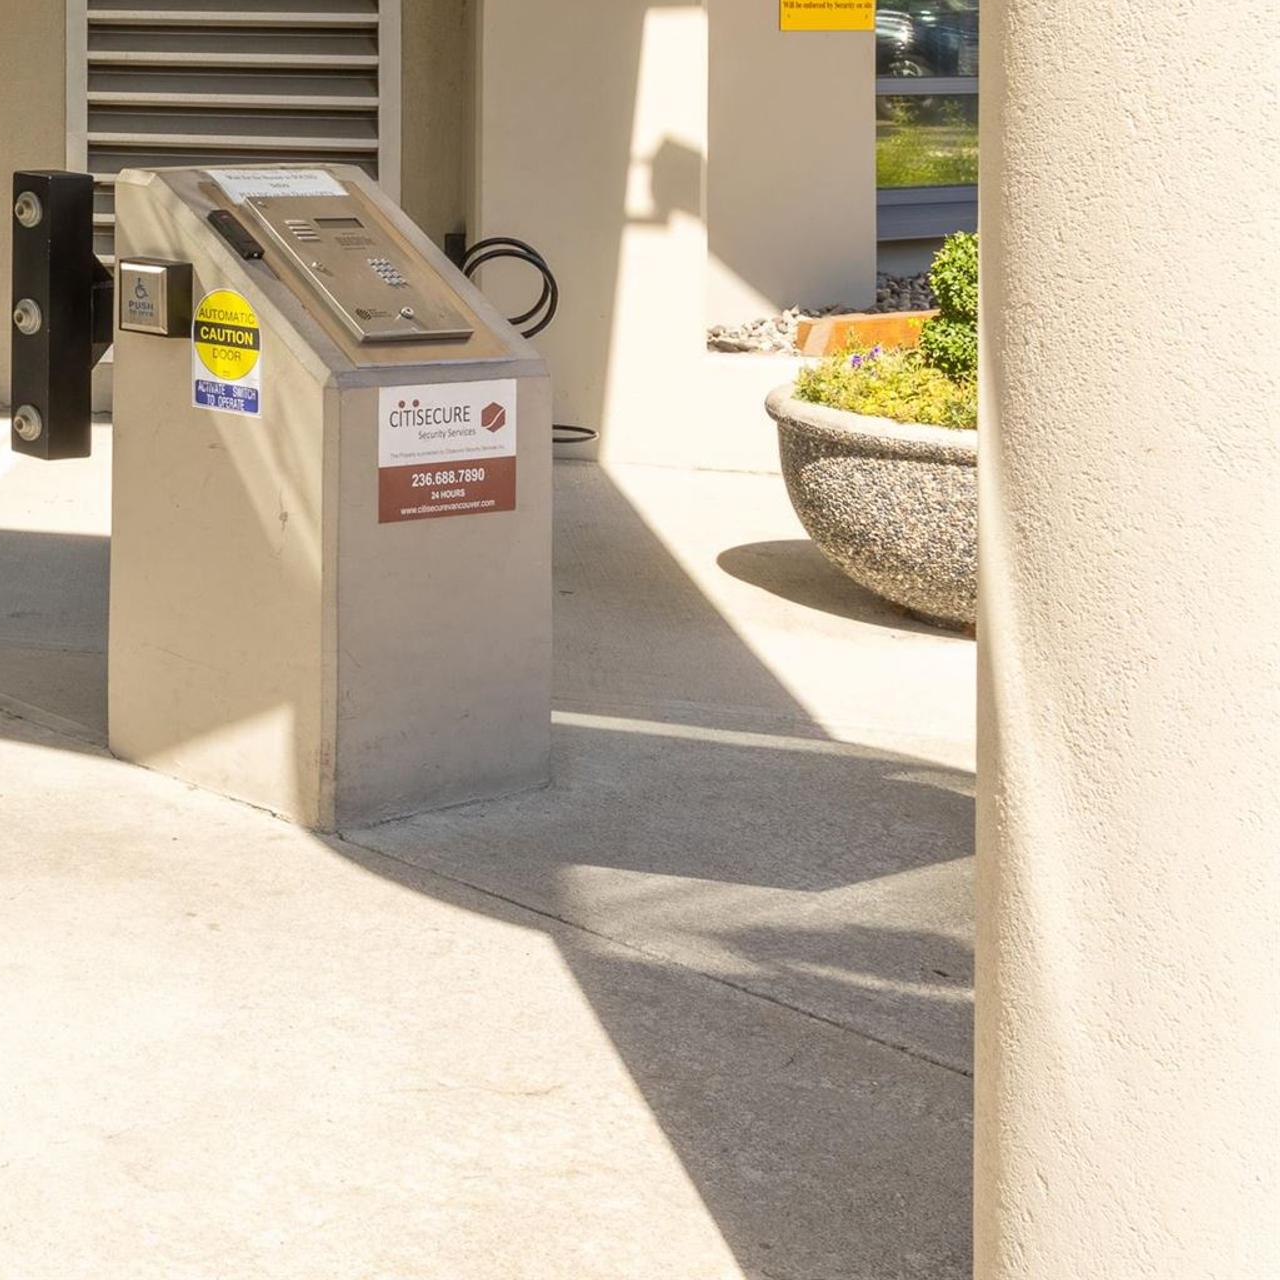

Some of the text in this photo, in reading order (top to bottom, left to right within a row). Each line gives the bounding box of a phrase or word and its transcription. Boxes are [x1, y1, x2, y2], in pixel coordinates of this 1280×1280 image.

[128, 300, 154, 310] PUSH
[198, 308, 256, 325] AUTOMATIC
[200, 326, 254, 345] CAUTION
[212, 348, 241, 361] DOOR
[197, 381, 257, 400] ACTIVATE SWITCH
[207, 393, 245, 411] TO OPERATE
[389, 400, 471, 428] CITISECURE
[418, 427, 477, 440] Security Services
[411, 467, 486, 488] 236.688.7890
[431, 488, 466, 500] 24 HOURS
[400, 499, 496, 515] www.citisecurevancouver.com
